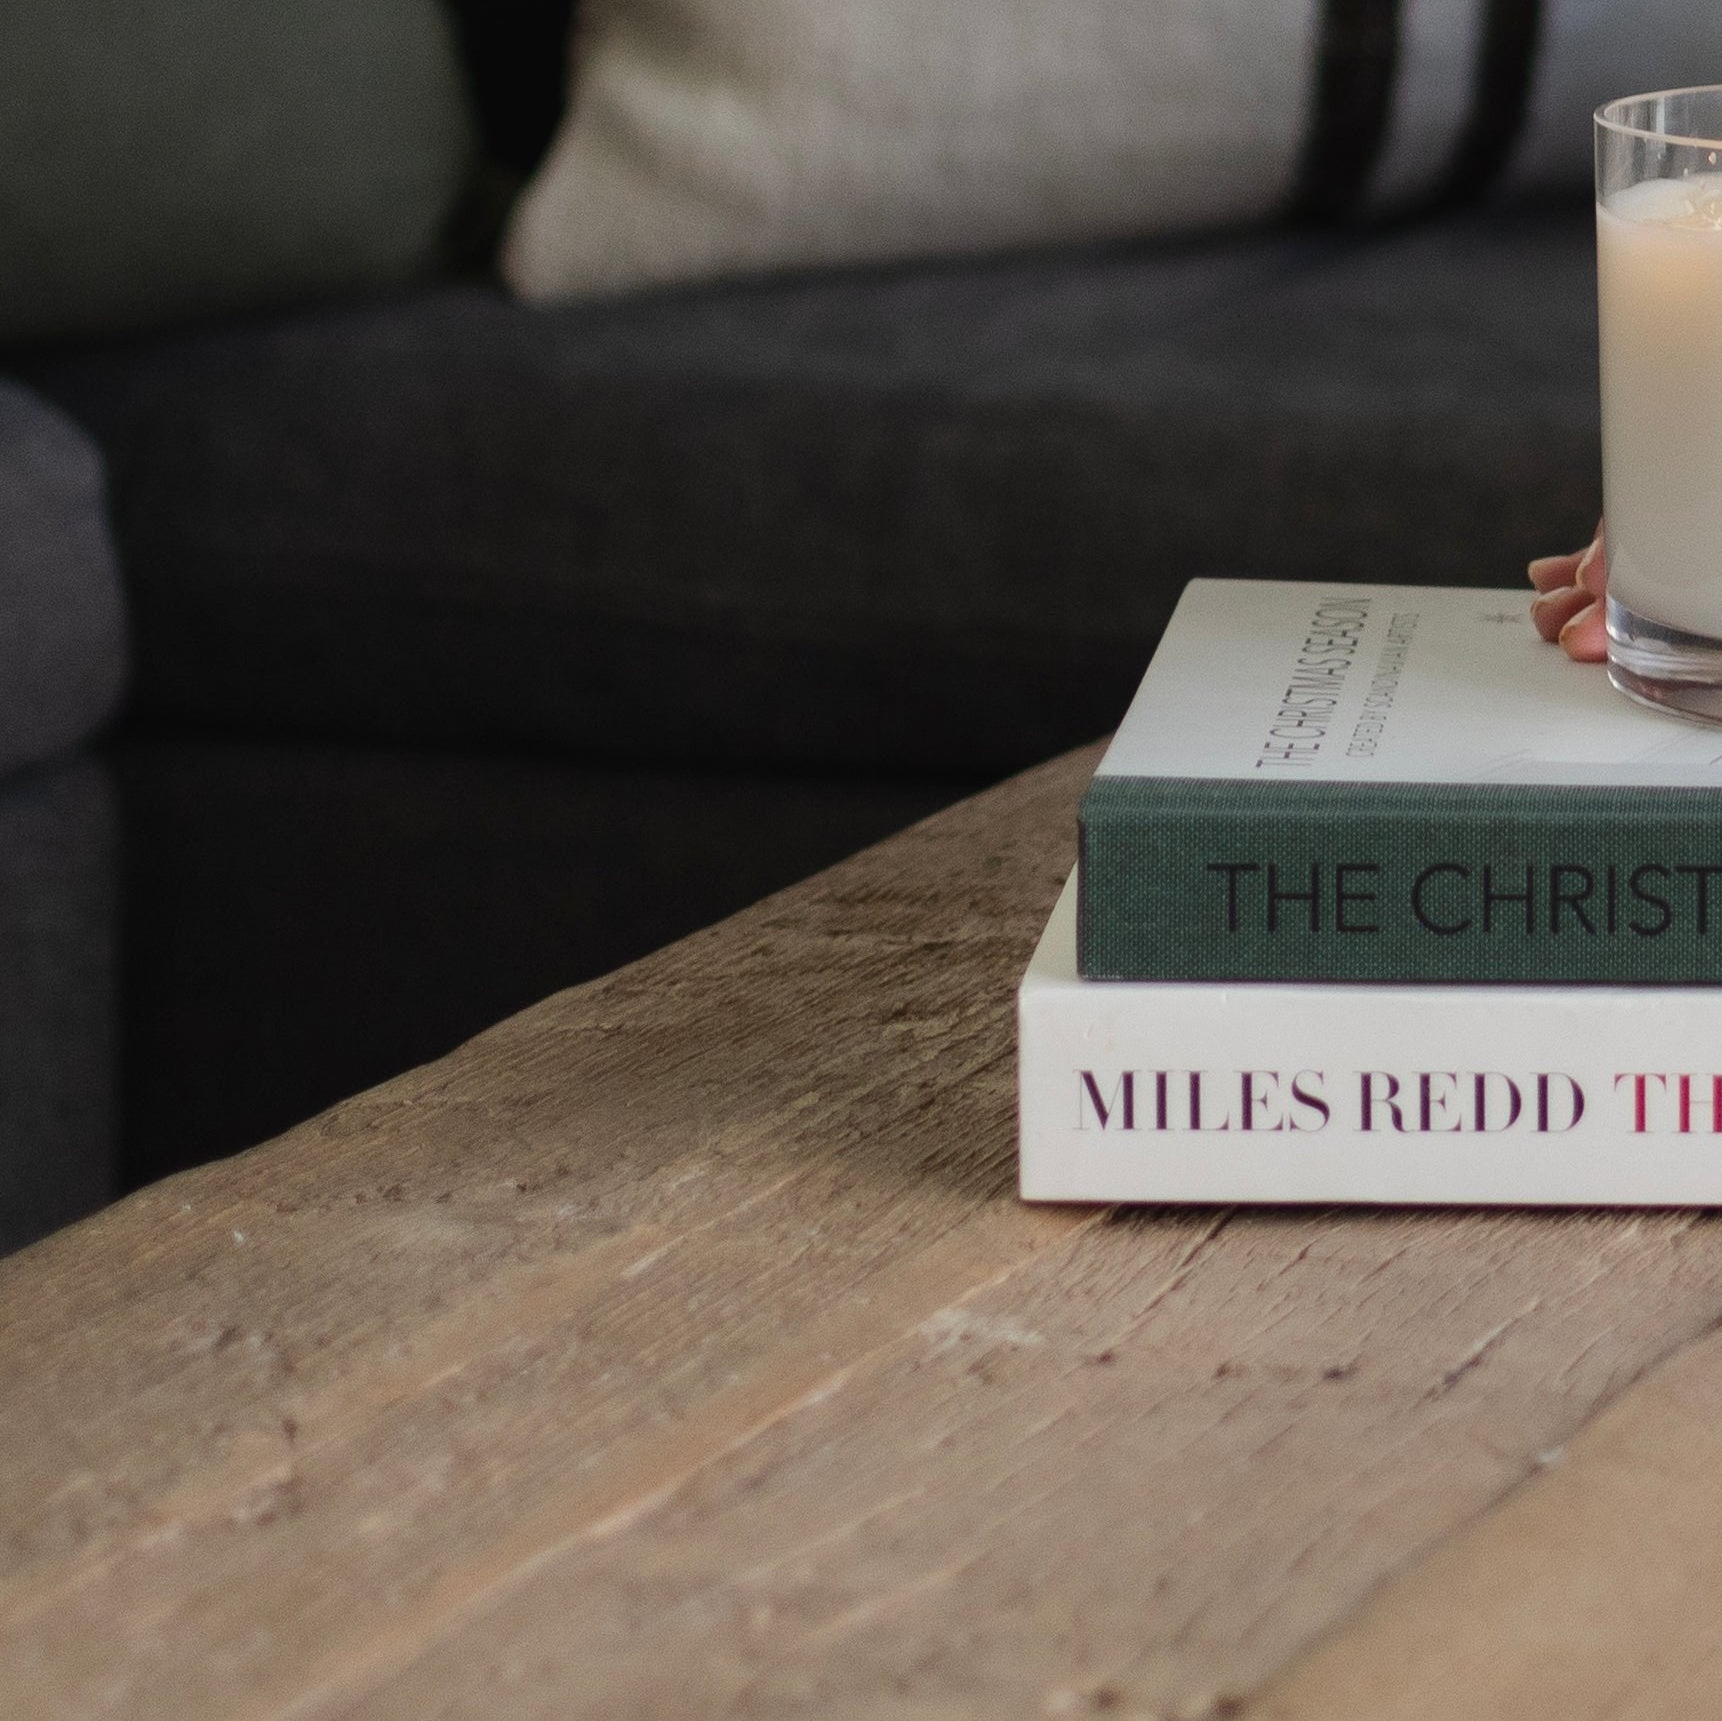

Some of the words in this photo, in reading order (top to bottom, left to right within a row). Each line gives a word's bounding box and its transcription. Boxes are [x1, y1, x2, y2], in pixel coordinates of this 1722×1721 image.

[1302, 597, 1372, 655] SEASON
[1269, 657, 1351, 738] CHRISTMAS
[1255, 741, 1320, 768] THE
[1207, 862, 1380, 934] THE
[1073, 1068, 1331, 1132] MILES
[1352, 1069, 1586, 1134] REDD
